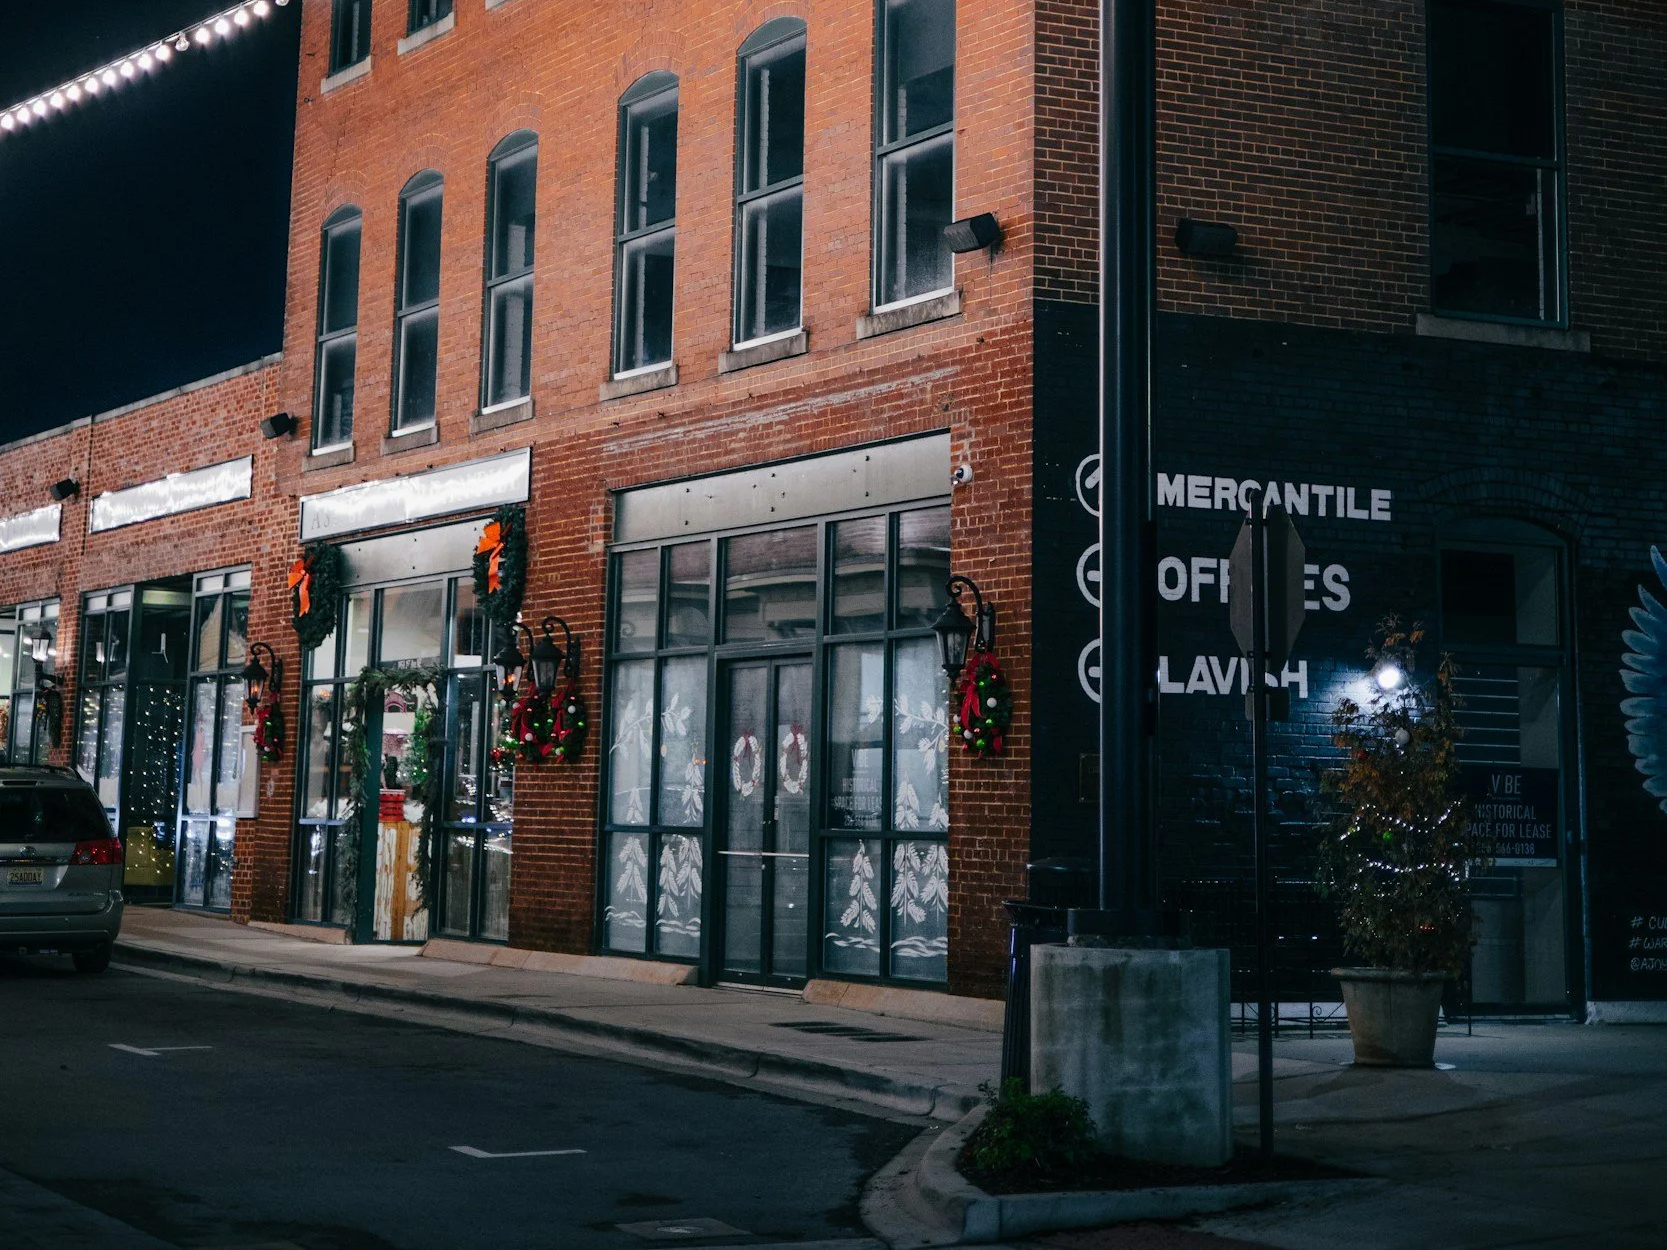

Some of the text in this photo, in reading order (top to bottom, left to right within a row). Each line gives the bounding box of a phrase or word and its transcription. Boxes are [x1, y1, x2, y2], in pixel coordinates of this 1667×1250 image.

[1157, 473, 1393, 522] MERCANTILE
[1466, 822, 1553, 839] PACE FOR LEASE
